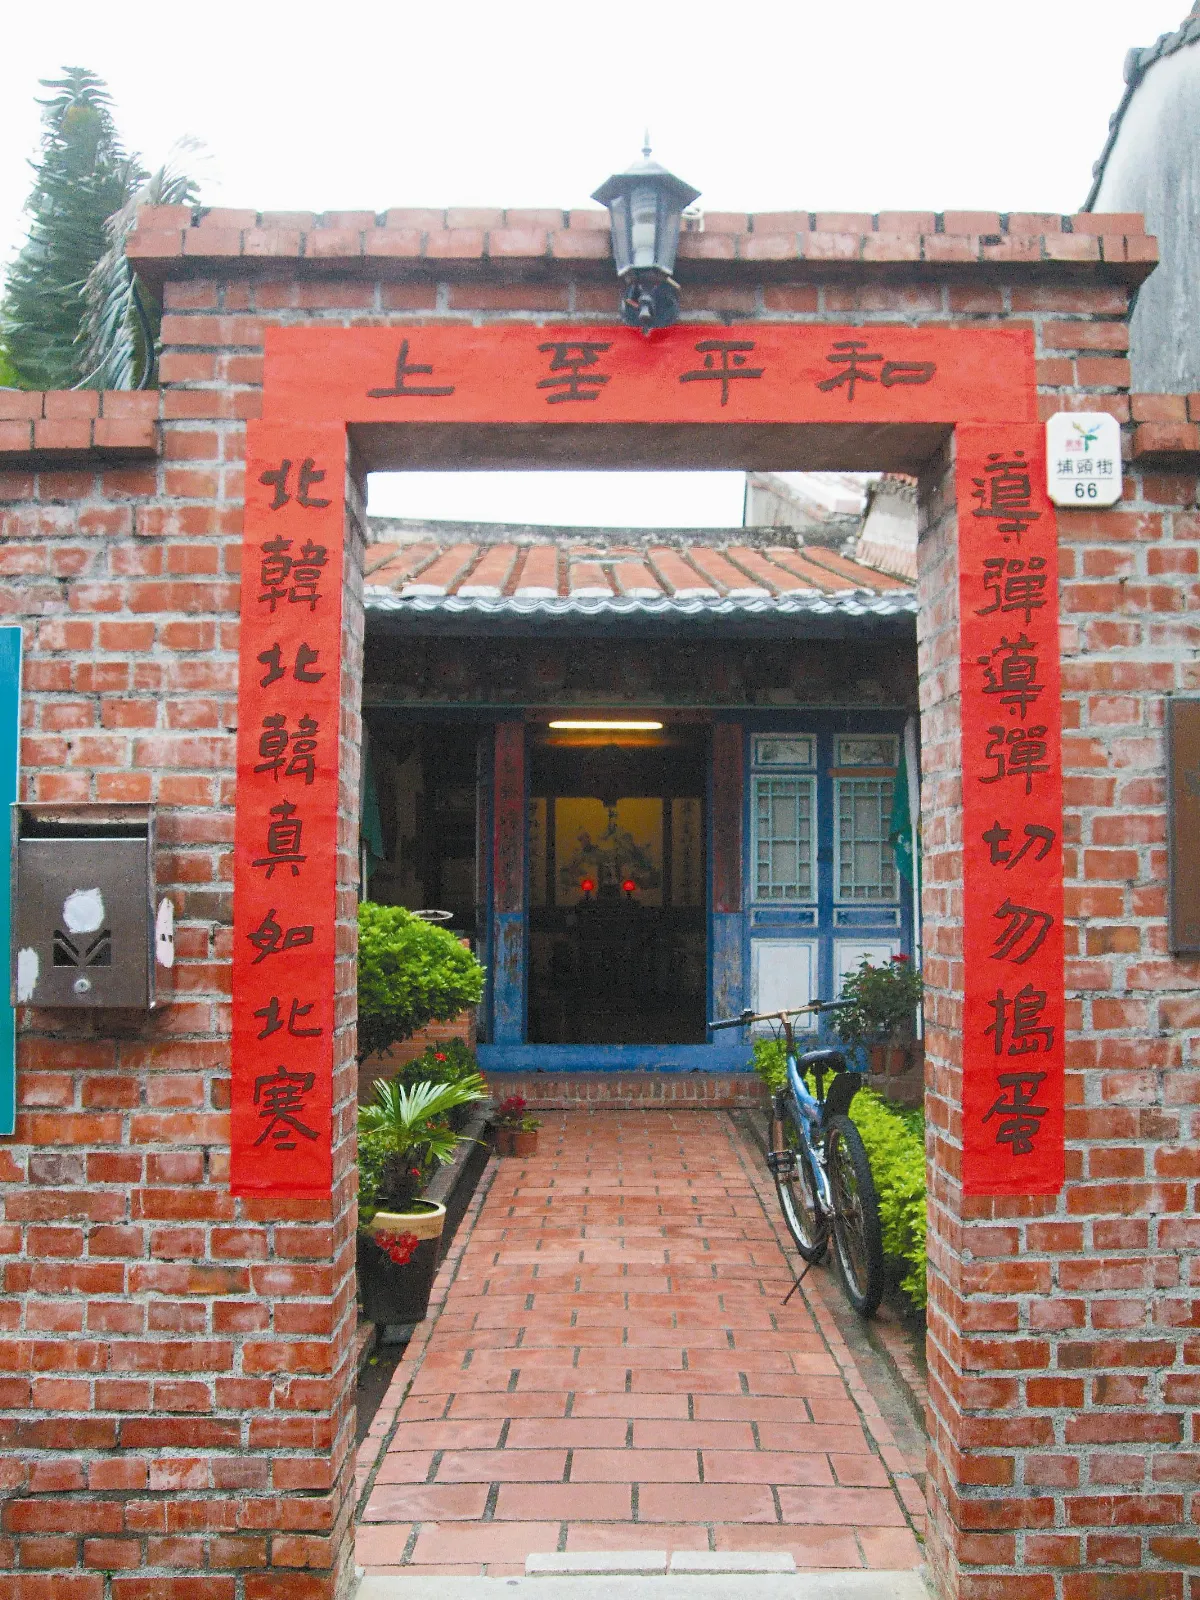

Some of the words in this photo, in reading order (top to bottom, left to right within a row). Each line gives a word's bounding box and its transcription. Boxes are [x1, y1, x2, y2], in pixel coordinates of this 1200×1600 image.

[1056, 458, 1113, 475] 埔頭街
[1075, 482, 1098, 498] 66
[247, 457, 333, 1150] 北韓北韓真如北寒
[971, 450, 1057, 1155] 導彈導彈切勿搗蛋
